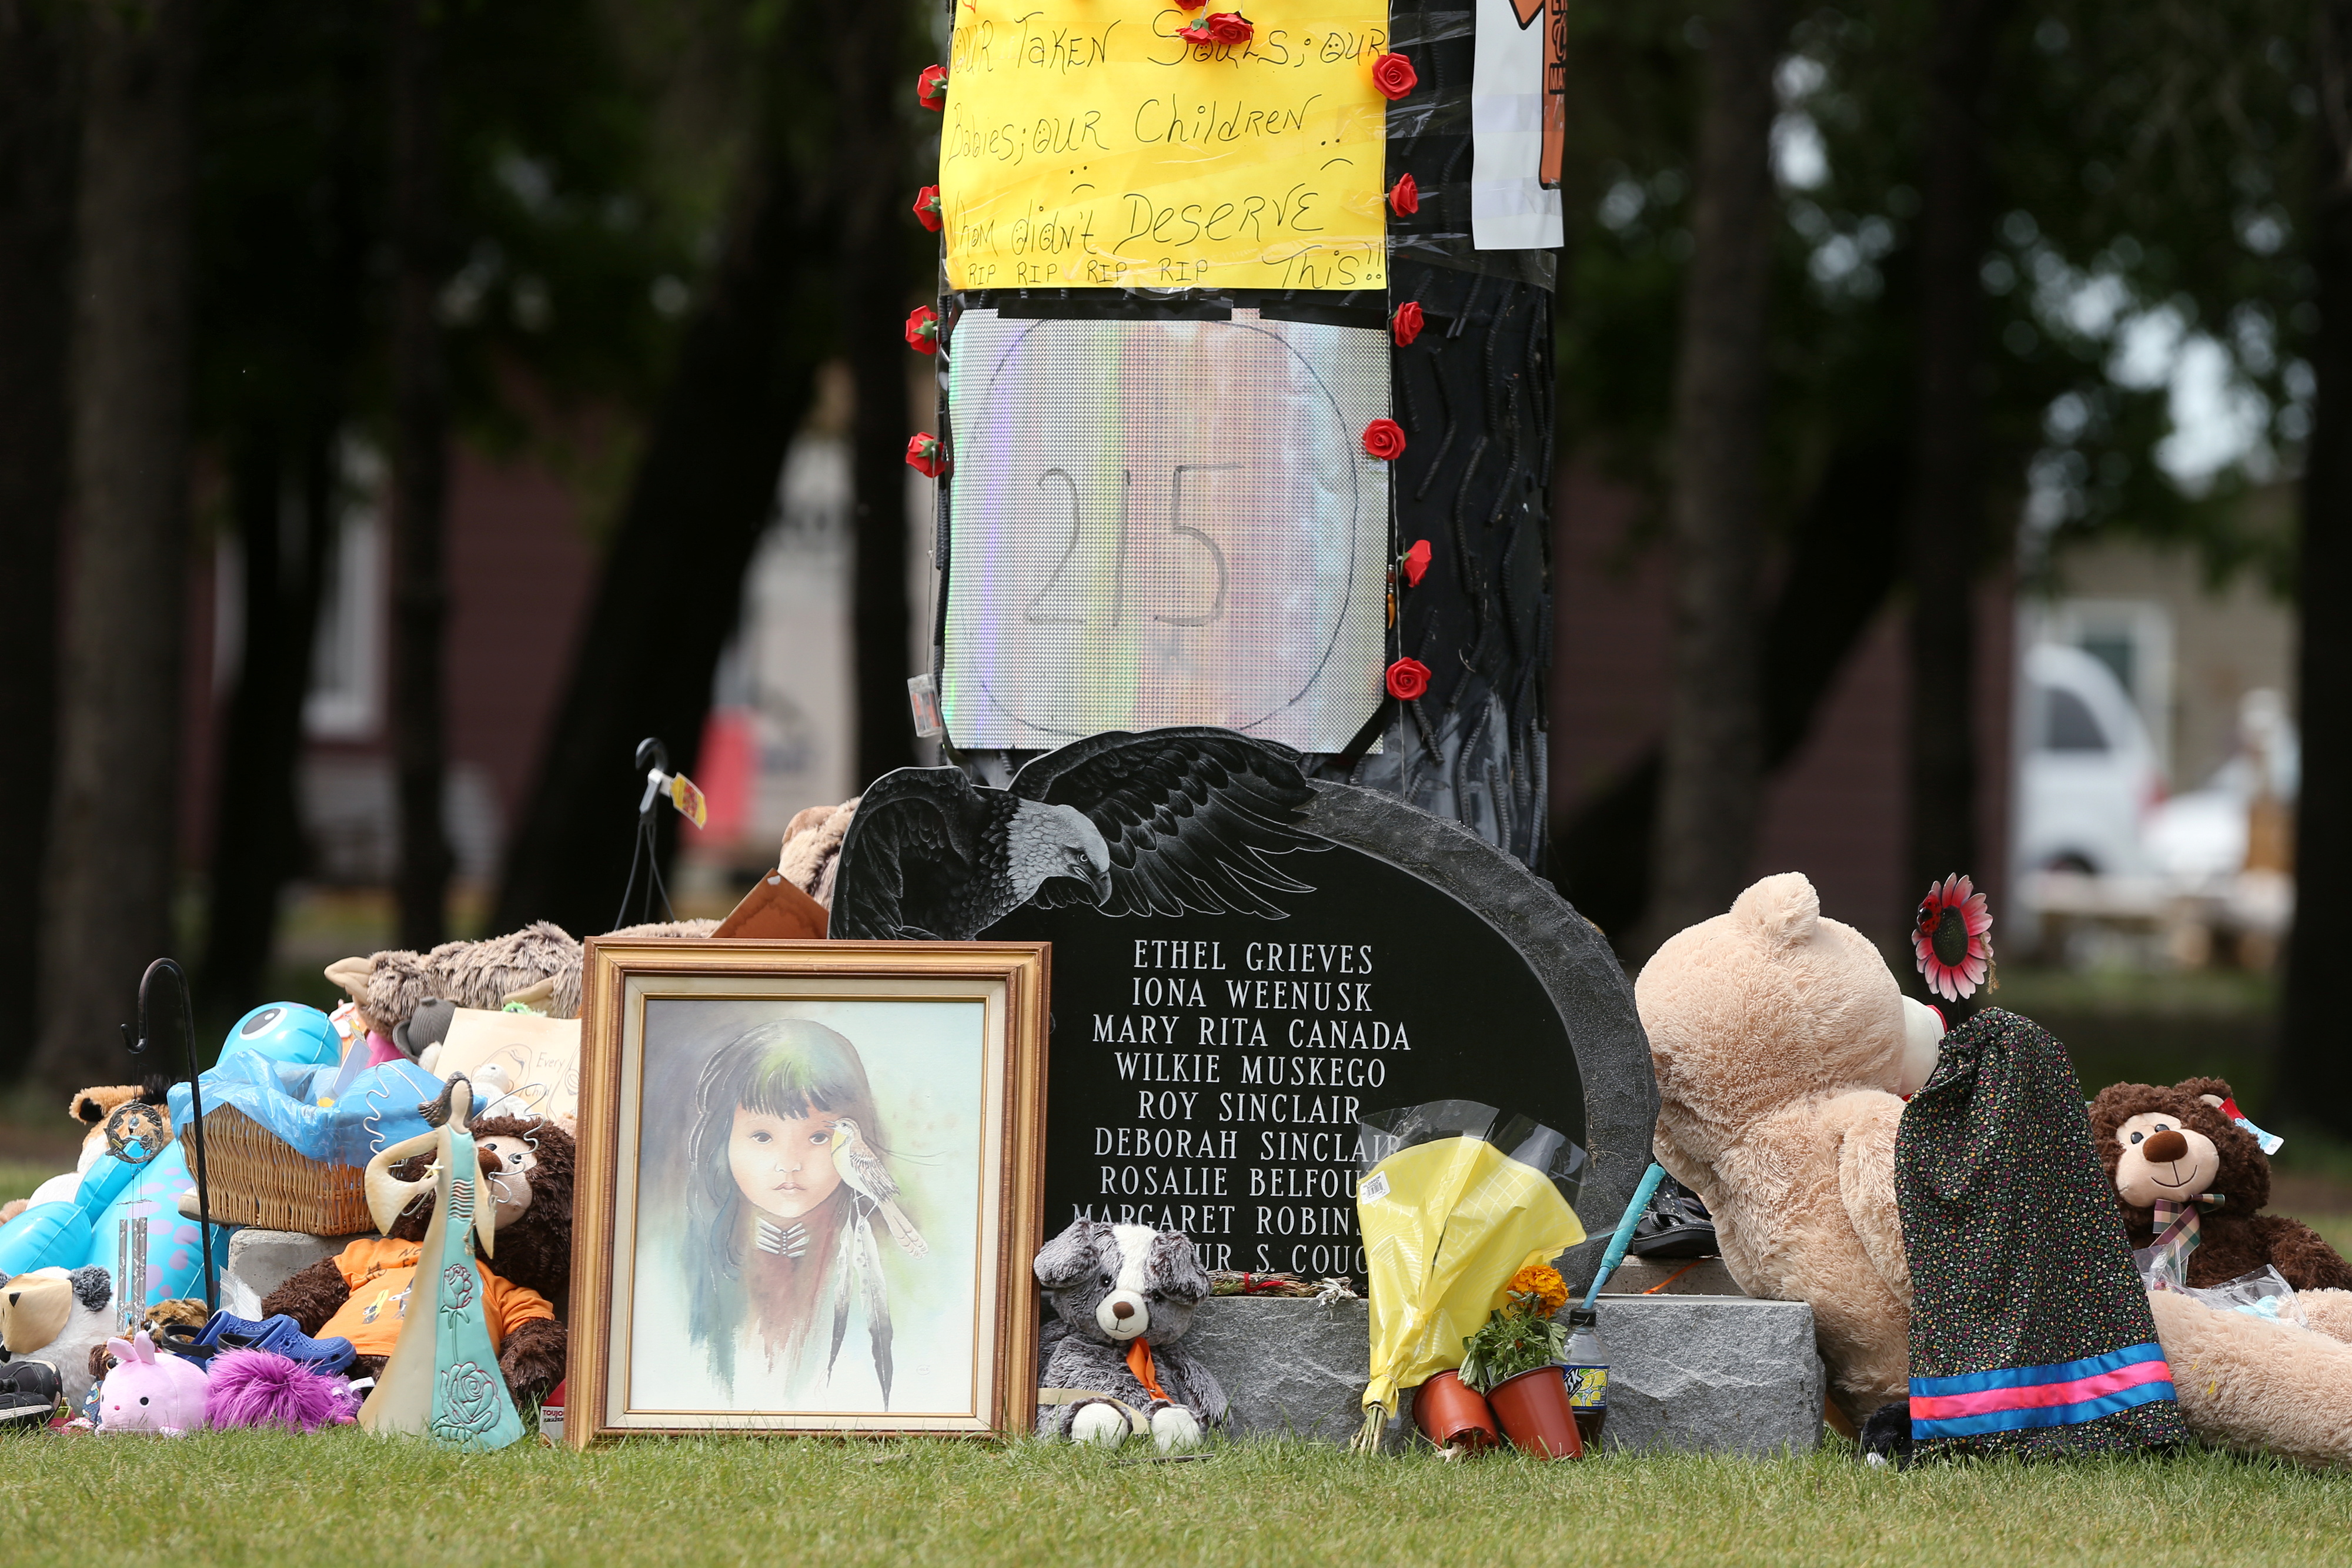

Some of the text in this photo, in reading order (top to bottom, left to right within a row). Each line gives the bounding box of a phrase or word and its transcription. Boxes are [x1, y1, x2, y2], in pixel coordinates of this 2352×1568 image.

[968, 258, 1208, 286] RIP RIP RIP RIP
[1025, 462, 1244, 627] 215
[1134, 940, 1373, 974] ETHEL GRIEVES
[1132, 977, 1373, 1011] IONA WEENUSK
[1092, 1014, 1411, 1051] MARY RITA CANADA
[536, 1051, 565, 1073] Every
[1114, 1052, 1385, 1088] WILKIE MUSKEGO
[1138, 1091, 1361, 1125] ROY SINCLAIR
[1094, 1127, 1238, 1159] DEBORAH
[1100, 1165, 1367, 1199] ROSALIE BELFOU
[1073, 1203, 1361, 1236] MARGARET ROBIN
[1256, 1243, 1275, 1272] S.
